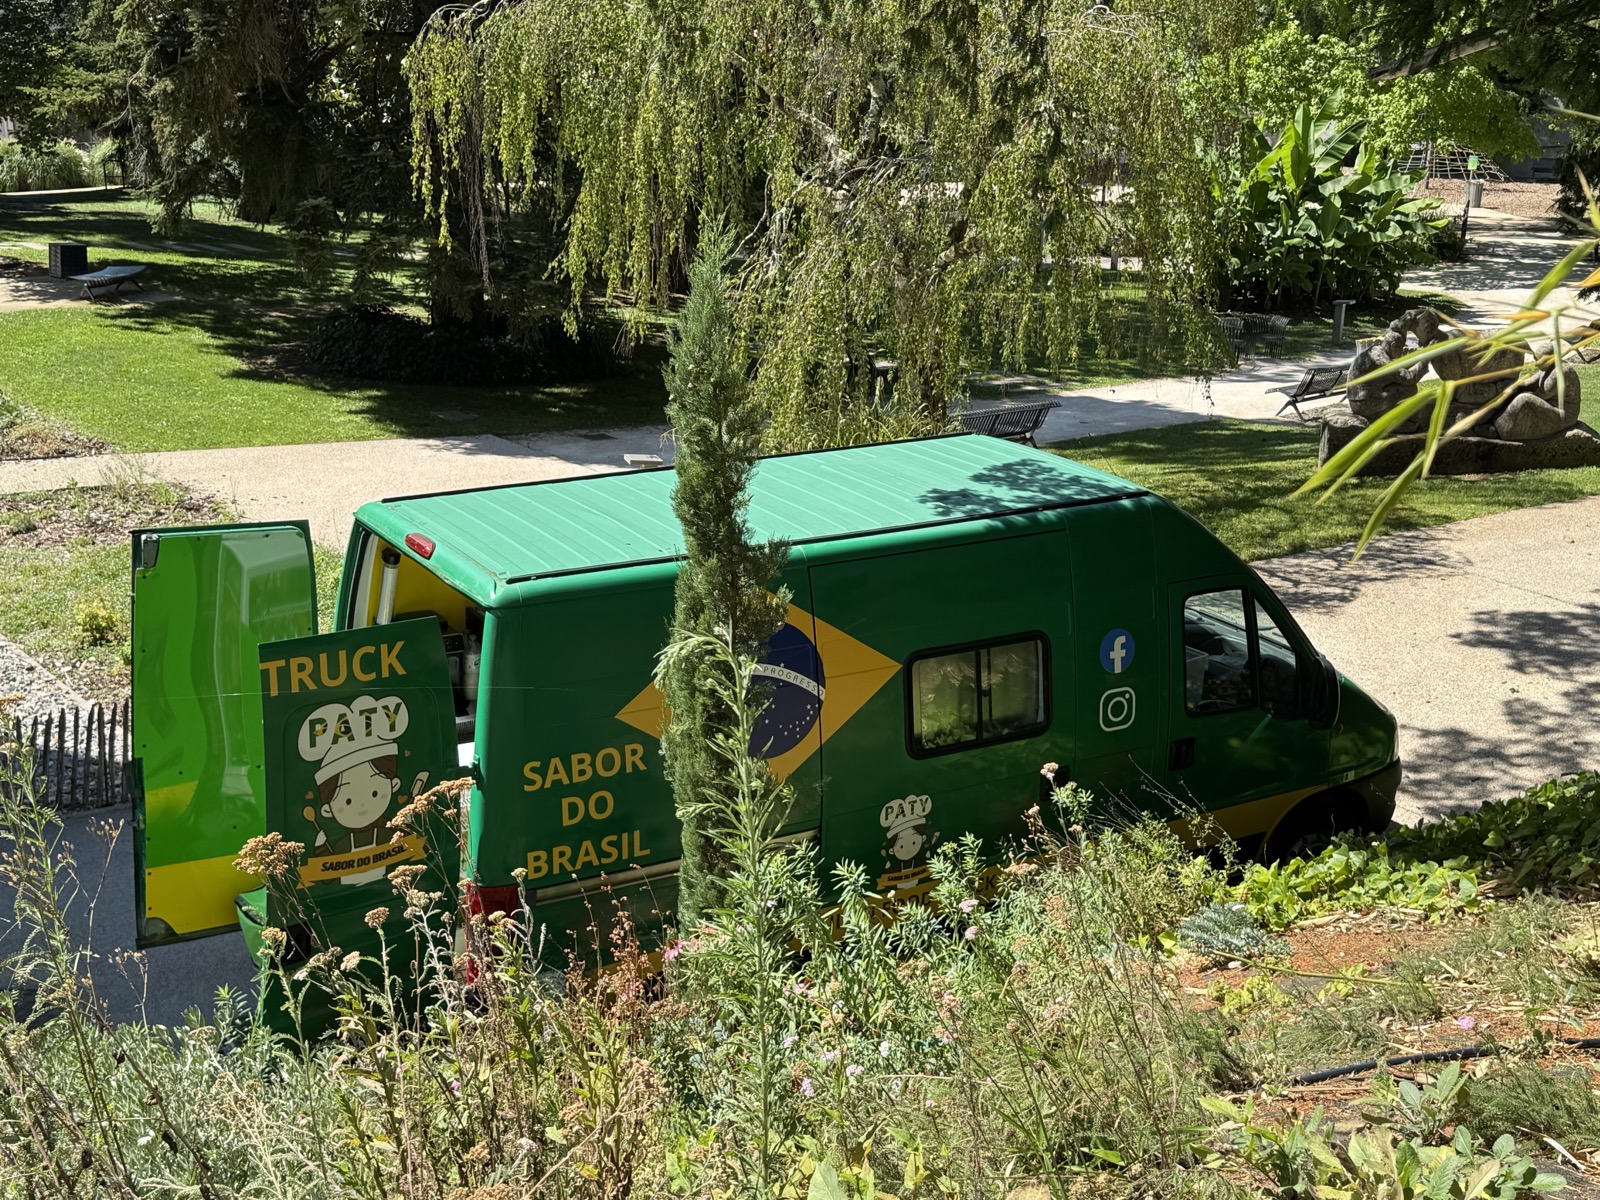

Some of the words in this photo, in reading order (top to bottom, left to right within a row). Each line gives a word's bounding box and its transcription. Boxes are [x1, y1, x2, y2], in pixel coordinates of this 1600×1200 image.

[259, 640, 407, 697] TRUCK
[308, 701, 402, 749] PATY
[523, 743, 647, 792] SABOR
[561, 790, 614, 827] DO
[884, 797, 929, 821] PATY
[321, 861, 356, 873] SABOR
[357, 855, 371, 868] DO
[373, 845, 407, 863] BRASIL
[527, 829, 651, 880] BRASIL
